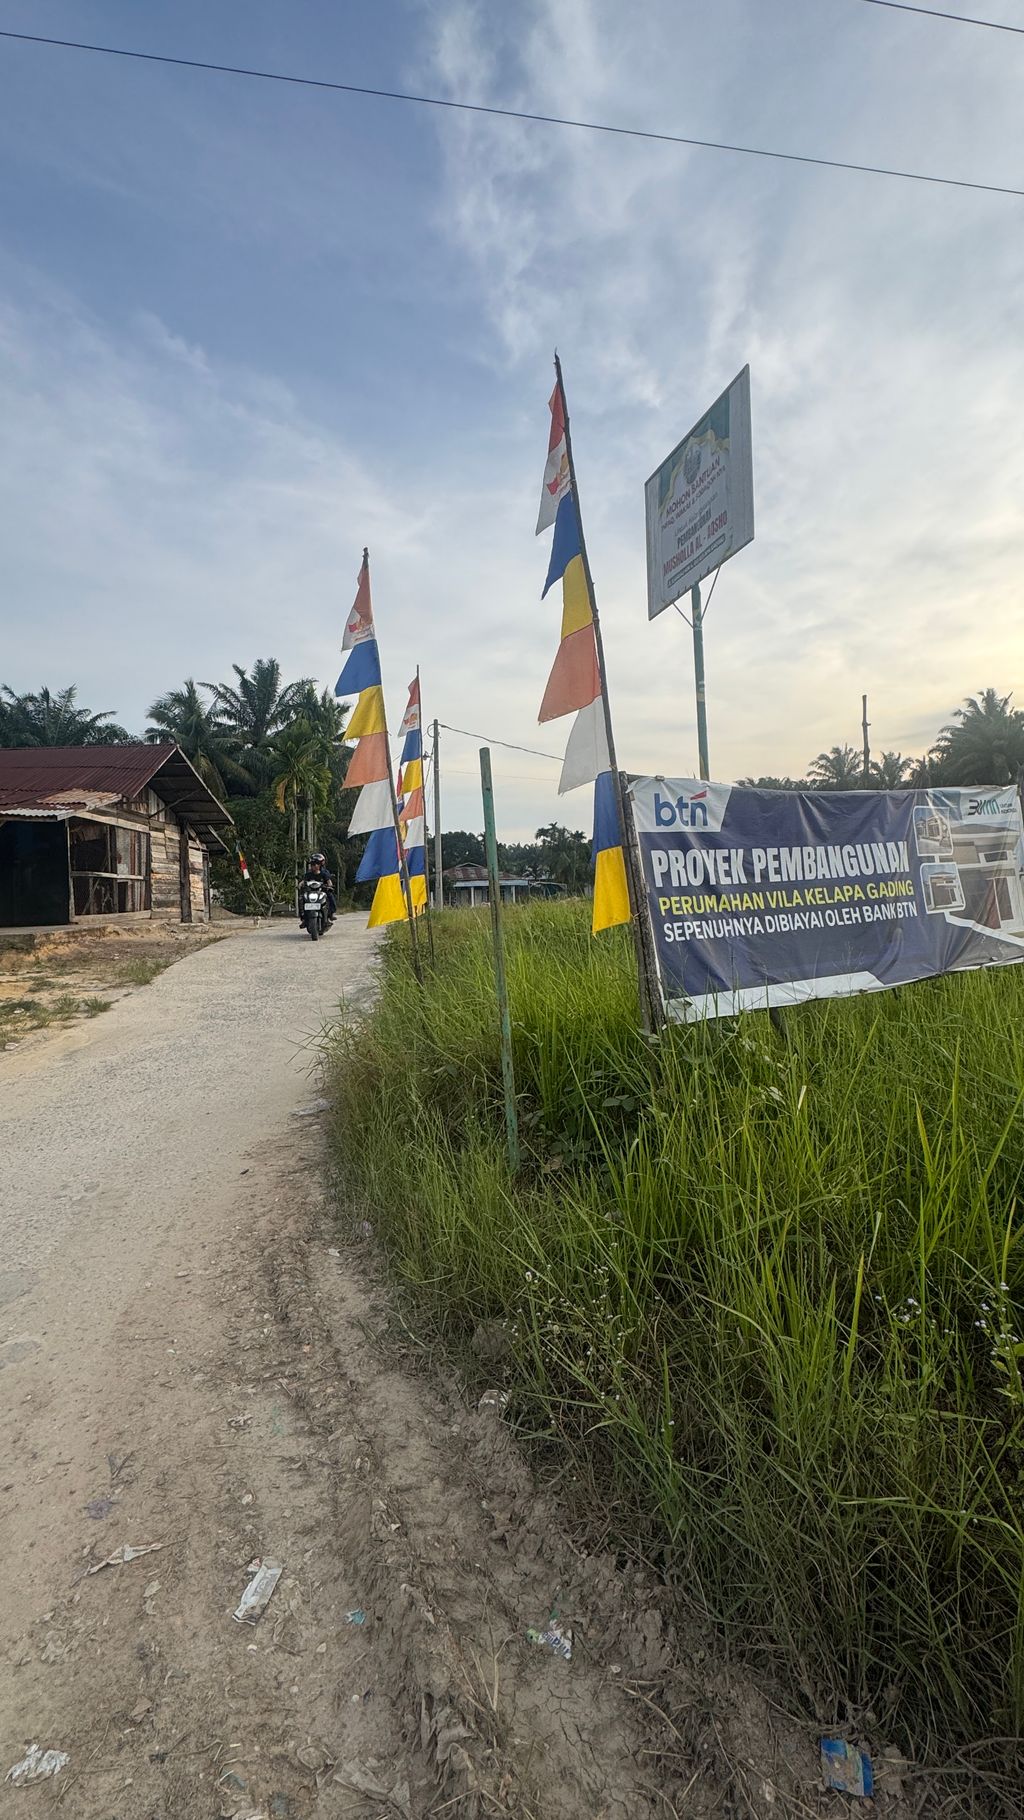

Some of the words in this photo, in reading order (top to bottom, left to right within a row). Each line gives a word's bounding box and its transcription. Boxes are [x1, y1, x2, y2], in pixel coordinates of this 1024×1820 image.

[666, 487, 691, 518] MOHON
[691, 455, 720, 495] BANTUAN
[663, 541, 694, 577] MUSHOLLA
[653, 791, 709, 827] btn
[651, 848, 748, 888] PROYEK
[751, 840, 910, 885] PEMBANGUNAN
[659, 891, 765, 916] PERUMAHAN
[765, 889, 804, 909] VILA
[804, 884, 865, 906] KELAPA
[866, 879, 914, 899] GADING
[663, 915, 765, 943] SEPENUHNYA
[765, 911, 824, 934] DIBIAYAI
[826, 907, 862, 926] OLEH
[863, 902, 896, 922] BANK
[897, 900, 918, 919] BTN
